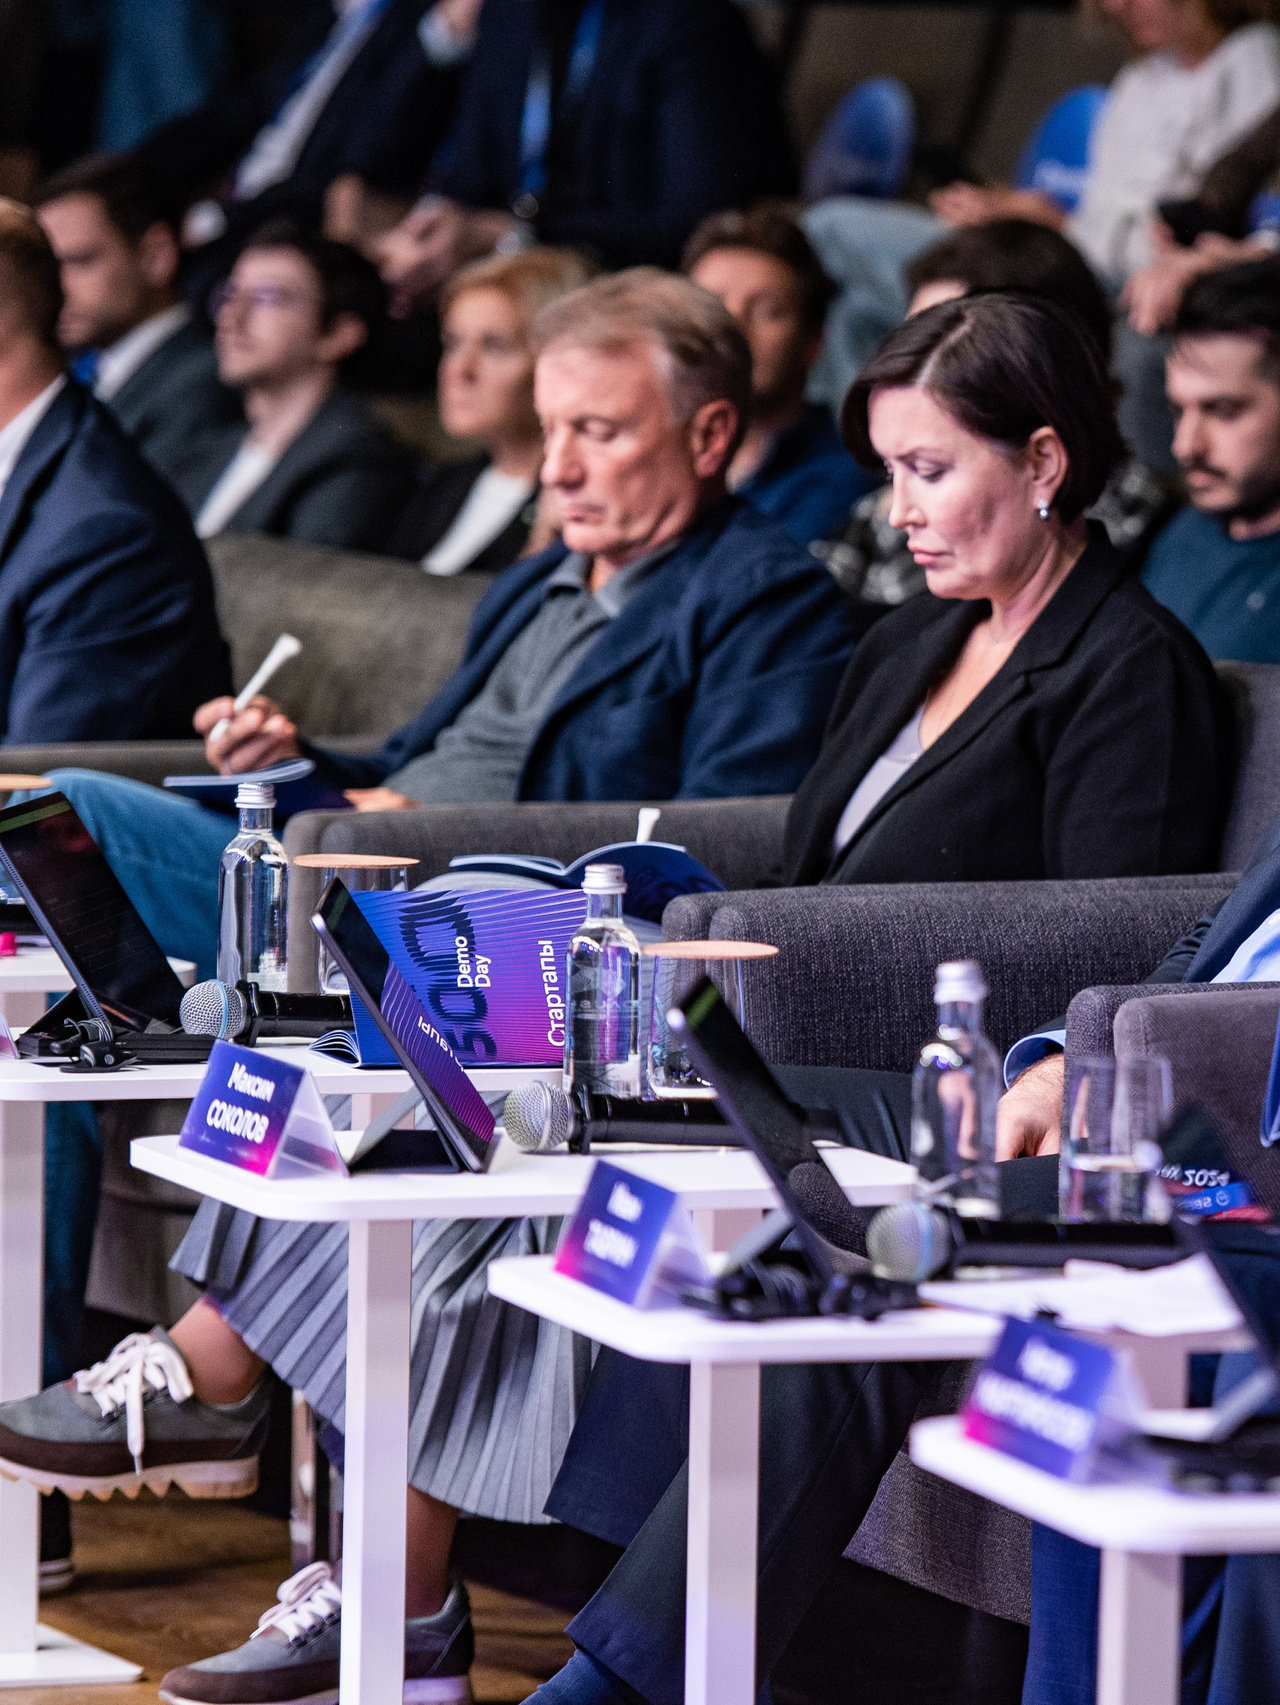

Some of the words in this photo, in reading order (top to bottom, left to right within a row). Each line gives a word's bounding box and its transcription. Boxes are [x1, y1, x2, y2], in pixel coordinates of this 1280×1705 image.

[457, 935, 474, 988] Demo
[475, 953, 491, 988] Day
[538, 939, 565, 1047] Стартапы
[227, 1062, 276, 1103] Максим
[206, 1098, 270, 1144] СОКОЛОВ
